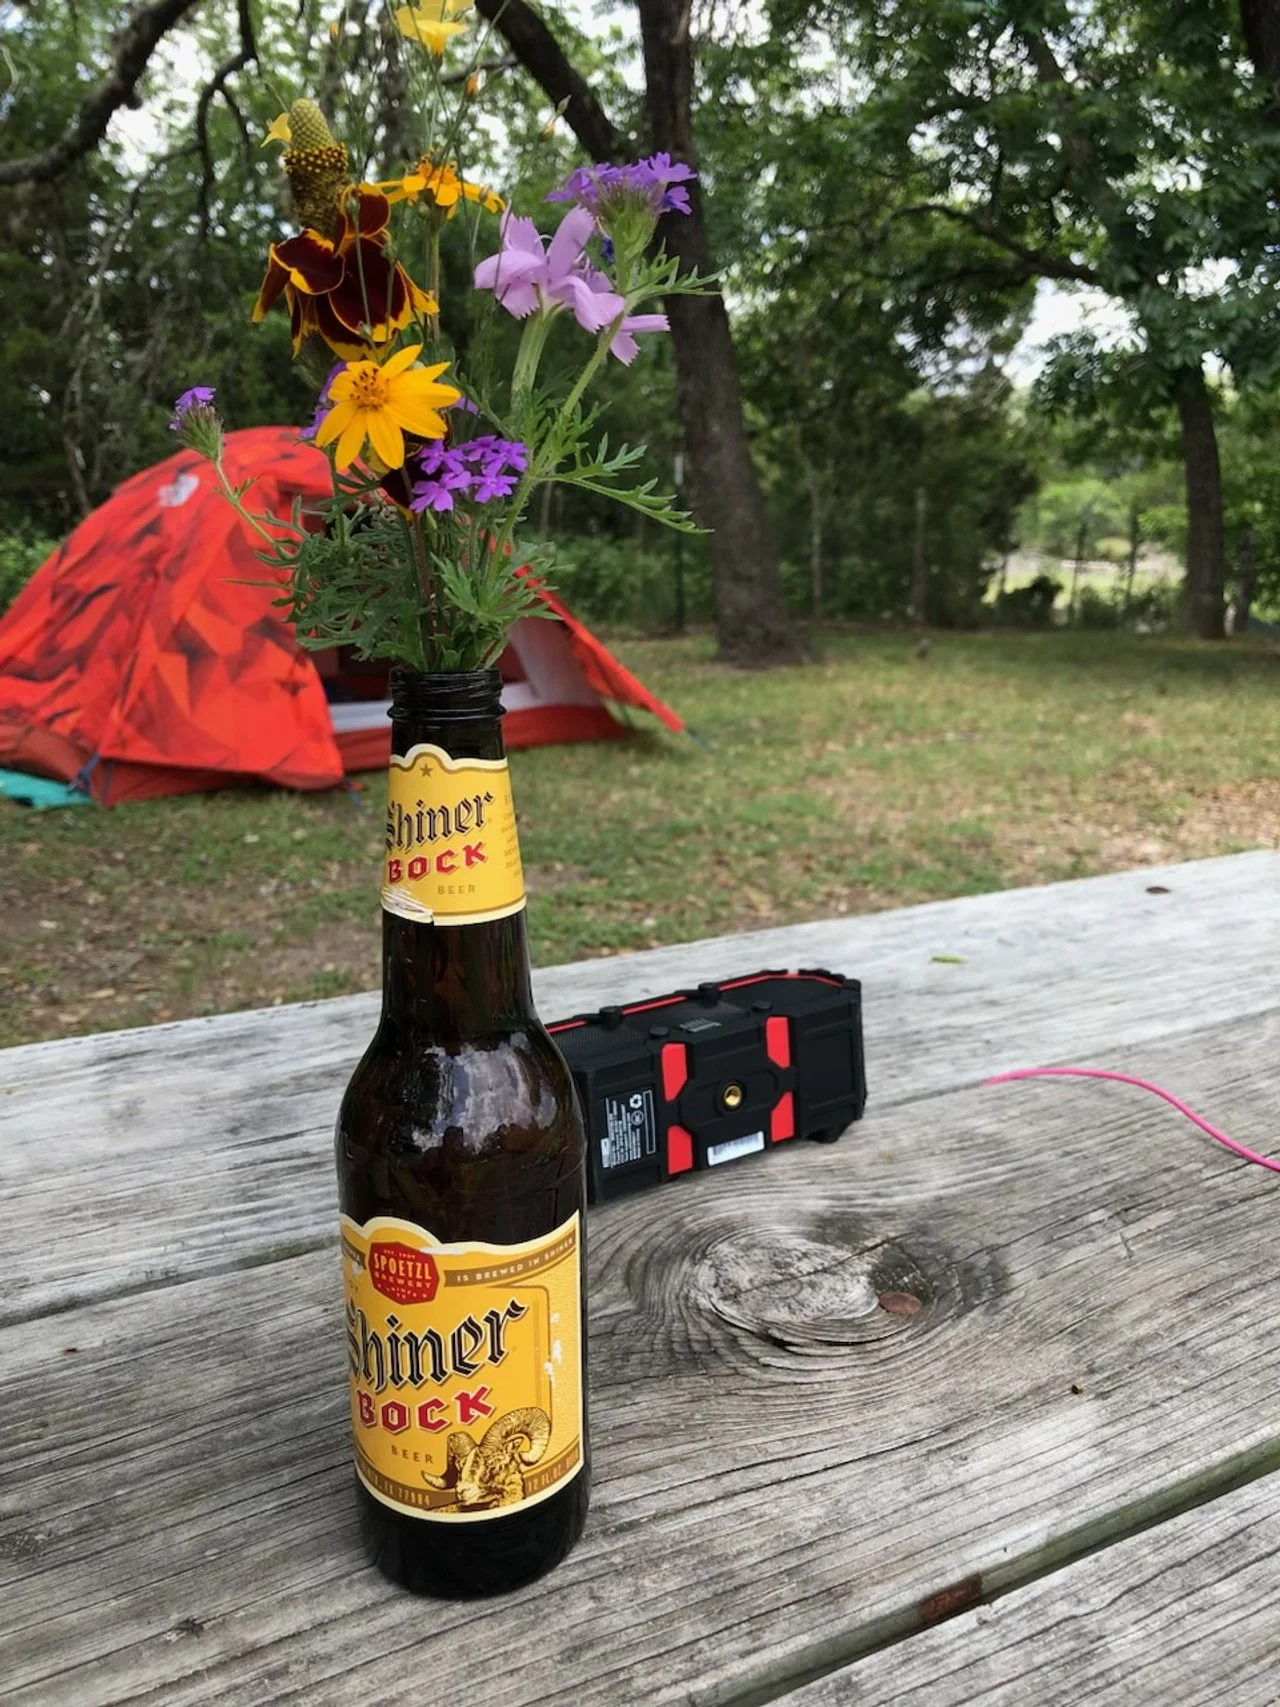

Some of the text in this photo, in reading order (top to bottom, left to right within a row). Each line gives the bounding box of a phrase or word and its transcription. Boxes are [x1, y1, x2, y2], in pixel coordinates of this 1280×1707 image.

[386, 791, 494, 852] Shiner
[388, 841, 488, 884] BOCK
[437, 884, 476, 895] BEER
[373, 1252, 432, 1280] SPOETZL
[457, 1274, 469, 1283] IS
[475, 1263, 524, 1281] BREWED
[528, 1258, 540, 1268] IN
[347, 1298, 526, 1391] Shiner
[357, 1385, 496, 1433] BOCK
[391, 1444, 434, 1464] BEER
